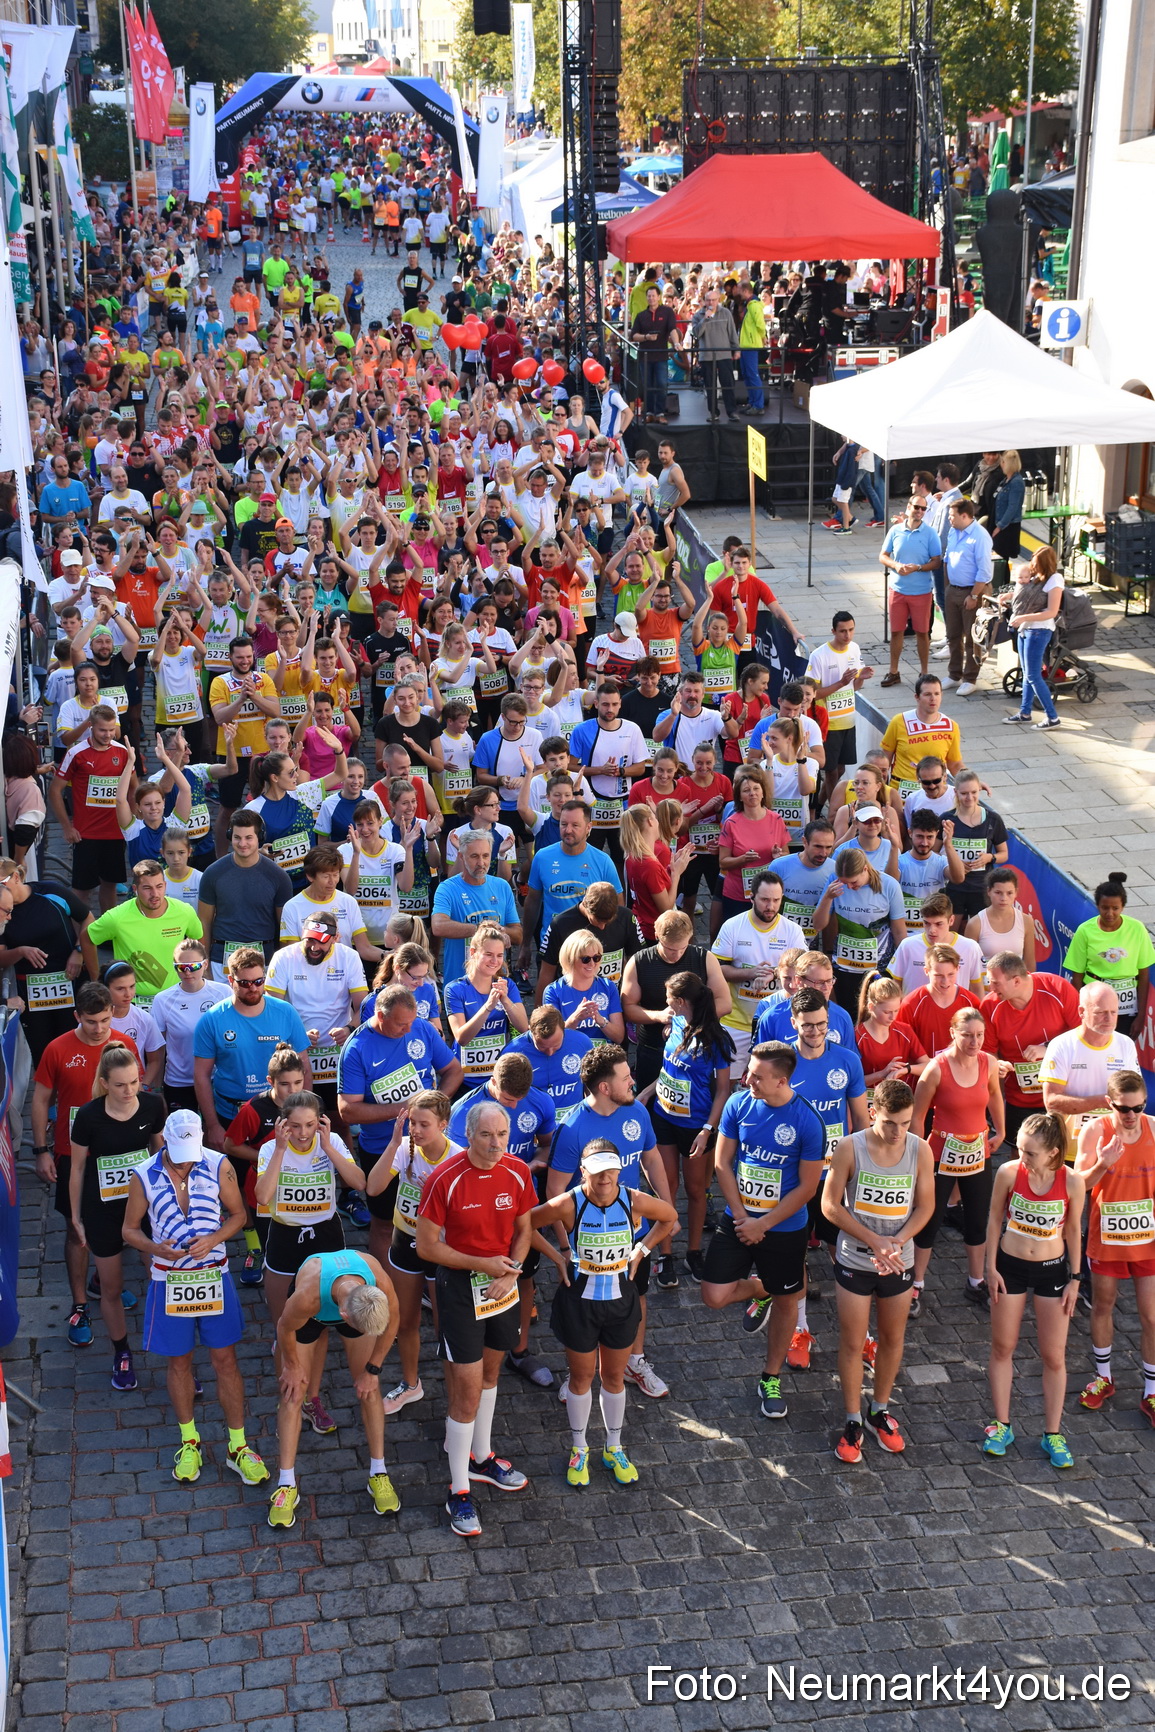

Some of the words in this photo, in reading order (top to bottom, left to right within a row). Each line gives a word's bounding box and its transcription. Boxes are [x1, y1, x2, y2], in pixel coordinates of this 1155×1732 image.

[216, 117, 236, 133] PARTL
[234, 98, 265, 122] NEUMARKT
[425, 102, 441, 117] PARTL
[387, 501, 406, 510] 5190
[399, 626, 409, 635] 79
[207, 650, 230, 660] 5279
[652, 647, 674, 657] 5172
[705, 669, 731, 677] BOCK
[484, 678, 506, 690] 5087
[707, 675, 731, 687] 5257
[166, 694, 195, 703] BOCK
[169, 702, 193, 714] 5273
[282, 704, 306, 714] 5098
[831, 699, 852, 711] 5278
[908, 735, 930, 745] MAX
[446, 769, 471, 778] BOCK
[92, 777, 120, 785] BOCK
[448, 779, 470, 790] 5171
[901, 781, 920, 789] BOC
[91, 786, 117, 797] 5188
[593, 801, 621, 809] BOCK
[595, 809, 621, 820] 5052
[275, 833, 307, 848] BOCK
[281, 859, 305, 868] JOHANN
[358, 876, 389, 885] BOCK
[356, 887, 387, 898] 5064
[400, 899, 427, 910] 5204
[839, 938, 874, 948] BOCK
[841, 947, 873, 961] 5133
[29, 972, 67, 984] BOCK
[32, 984, 68, 999] 5115
[35, 999, 68, 1007] SUSANNE
[467, 1049, 501, 1063] 5072
[664, 1051, 691, 1071] LÄUFT
[1017, 1063, 1042, 1073] BOC
[246, 1074, 258, 1083] 18.
[374, 1065, 415, 1092] BOCK
[1022, 1075, 1041, 1086] 51
[381, 1080, 418, 1103] 5080
[548, 1081, 578, 1097] ÄUFT
[658, 1083, 685, 1105] 5082
[812, 1098, 842, 1111] ÄUFT
[948, 1140, 983, 1153] BOCK
[101, 1153, 142, 1168] BOCK
[742, 1144, 788, 1165] LÄUFT
[946, 1150, 982, 1165] 5102
[738, 1164, 777, 1180] BOCK
[946, 1164, 980, 1173] MANUELA
[105, 1168, 131, 1185] 525
[282, 1173, 328, 1185] BOCK
[863, 1174, 908, 1188] BOCK
[403, 1184, 421, 1199] BO
[739, 1178, 774, 1198] 5076
[283, 1188, 326, 1202] 5003
[862, 1187, 905, 1204] 5266
[285, 1204, 322, 1212] LUCIANA
[400, 1200, 418, 1214] 51
[745, 1199, 761, 1208] MAX
[1014, 1198, 1059, 1213] BOCK
[1103, 1201, 1151, 1213] BOCK
[1014, 1210, 1056, 1227] 5001
[1107, 1215, 1150, 1231] 5000
[1017, 1224, 1052, 1237] VANESSA
[1107, 1232, 1150, 1241] CHRISTOPH
[583, 1233, 627, 1245] BOCK
[584, 1247, 625, 1264] 5141
[588, 1263, 620, 1273] MONIKA
[174, 1270, 217, 1283] BOCK
[173, 1286, 217, 1302] 5061
[176, 1304, 213, 1313] MARKUS
